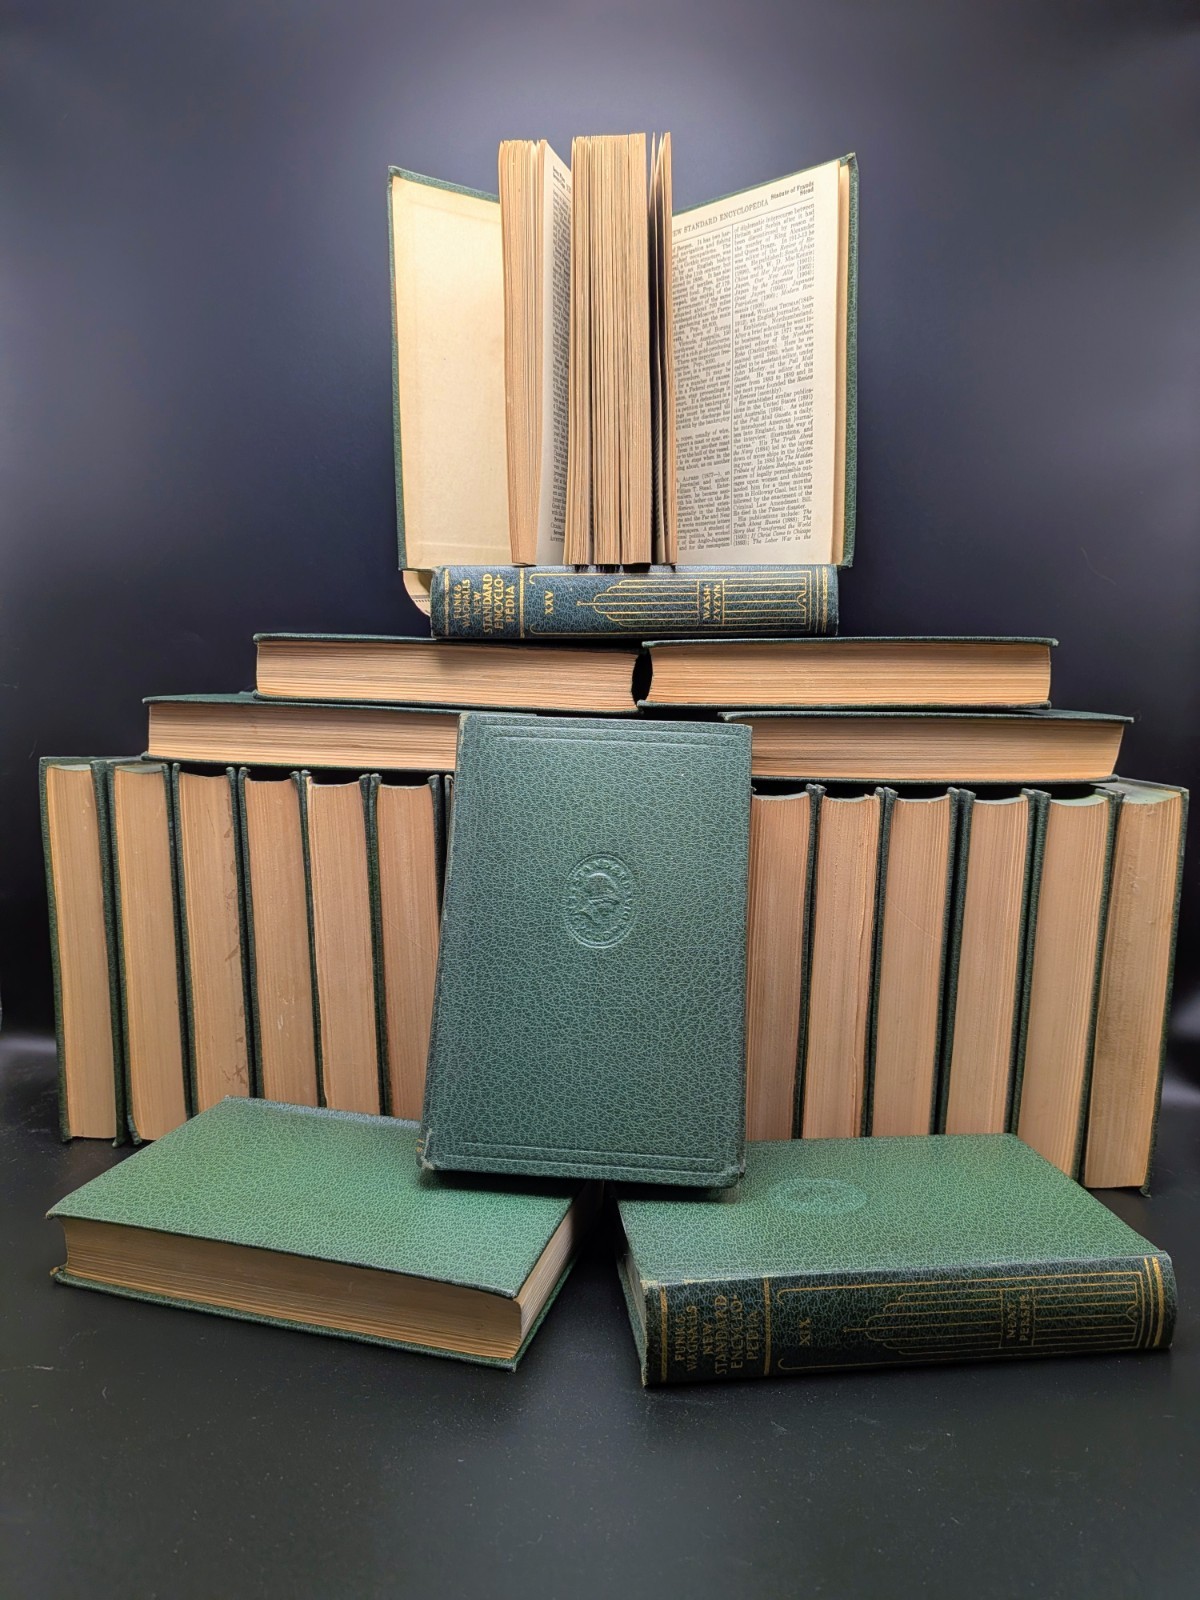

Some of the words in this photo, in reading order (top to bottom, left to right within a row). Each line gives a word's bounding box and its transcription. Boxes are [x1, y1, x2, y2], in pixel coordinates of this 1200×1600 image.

[683, 216, 718, 233] STANDARD
[720, 199, 769, 222] ENCYCLOPEDIA
[453, 584, 462, 592] &
[453, 593, 462, 619] FUNK
[461, 579, 471, 628] WAGNALLS
[473, 591, 482, 615] NEW
[482, 573, 493, 634] STANDARD
[493, 573, 504, 630] ENCYCLO-
[505, 585, 516, 623] PEDIA
[544, 590, 554, 615] XXV
[674, 1327, 686, 1361] FUNK
[686, 1305, 698, 1372] WAGNALLS
[702, 1321, 714, 1355] NEW
[714, 1294, 728, 1375] STANDARD
[730, 1294, 744, 1369] ENCYCLO-
[746, 1310, 760, 1360] PEDIA
